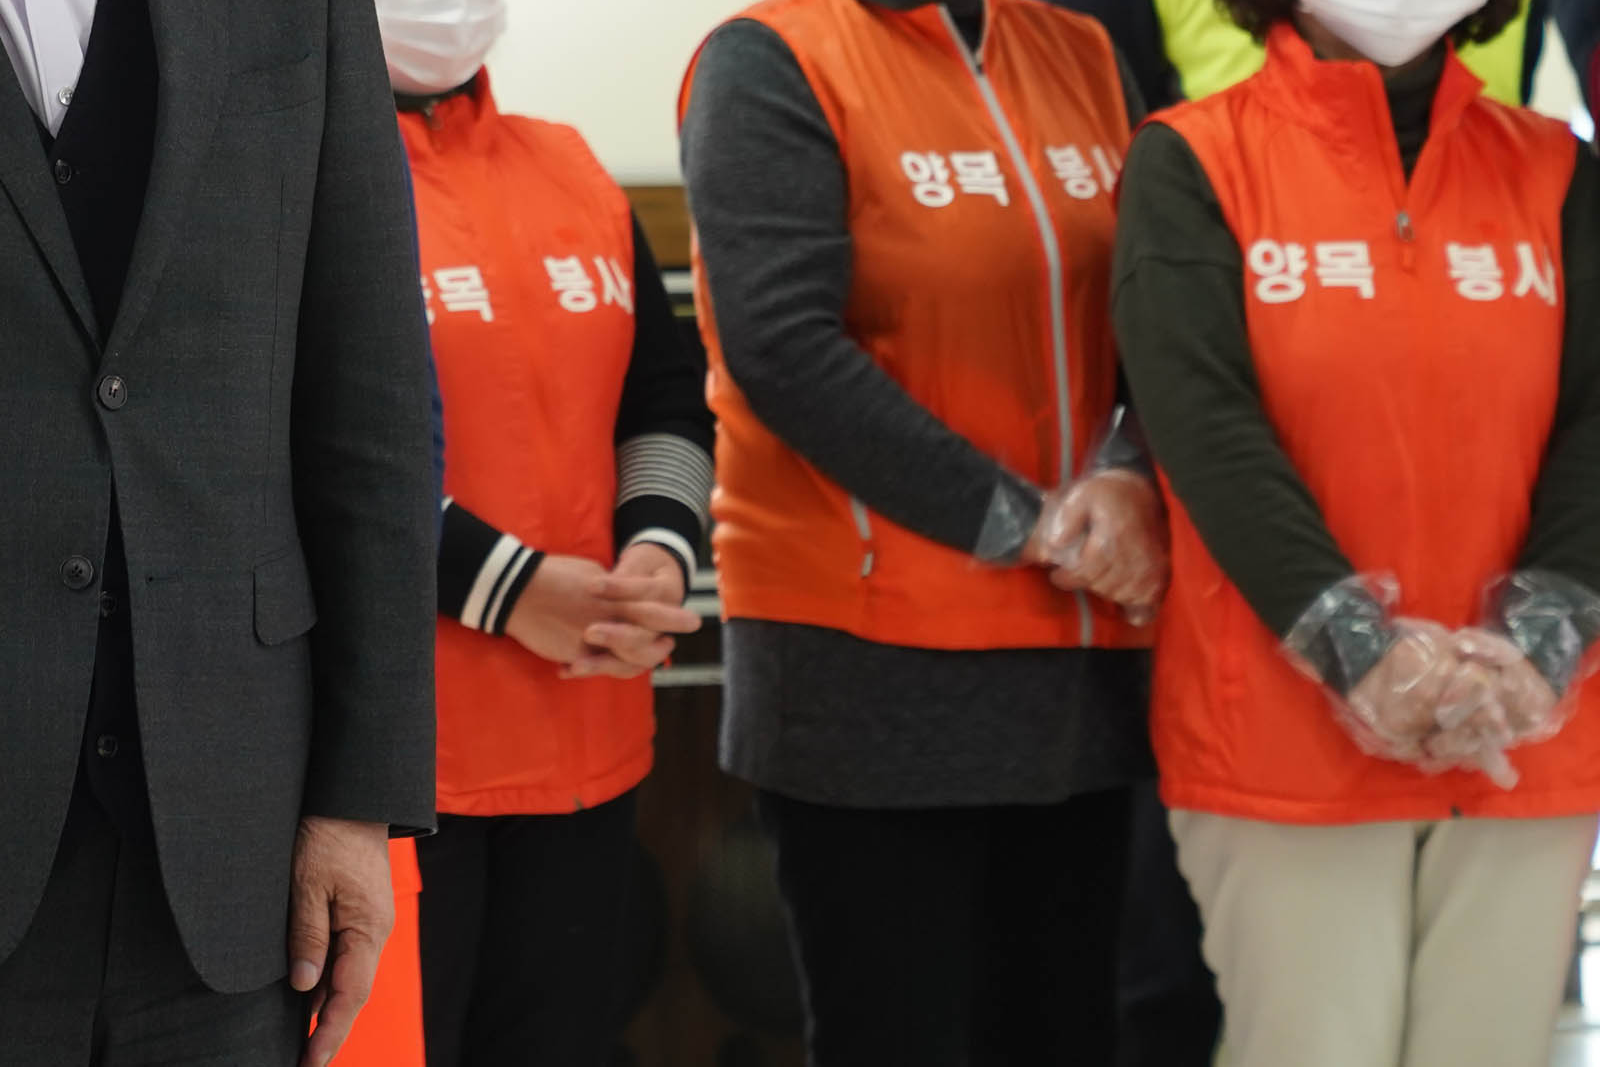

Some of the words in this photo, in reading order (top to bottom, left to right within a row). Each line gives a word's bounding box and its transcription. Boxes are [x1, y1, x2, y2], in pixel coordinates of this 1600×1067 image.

[901, 151, 1009, 208] 양목
[421, 266, 494, 325] 목
[1249, 239, 1374, 304] 양목
